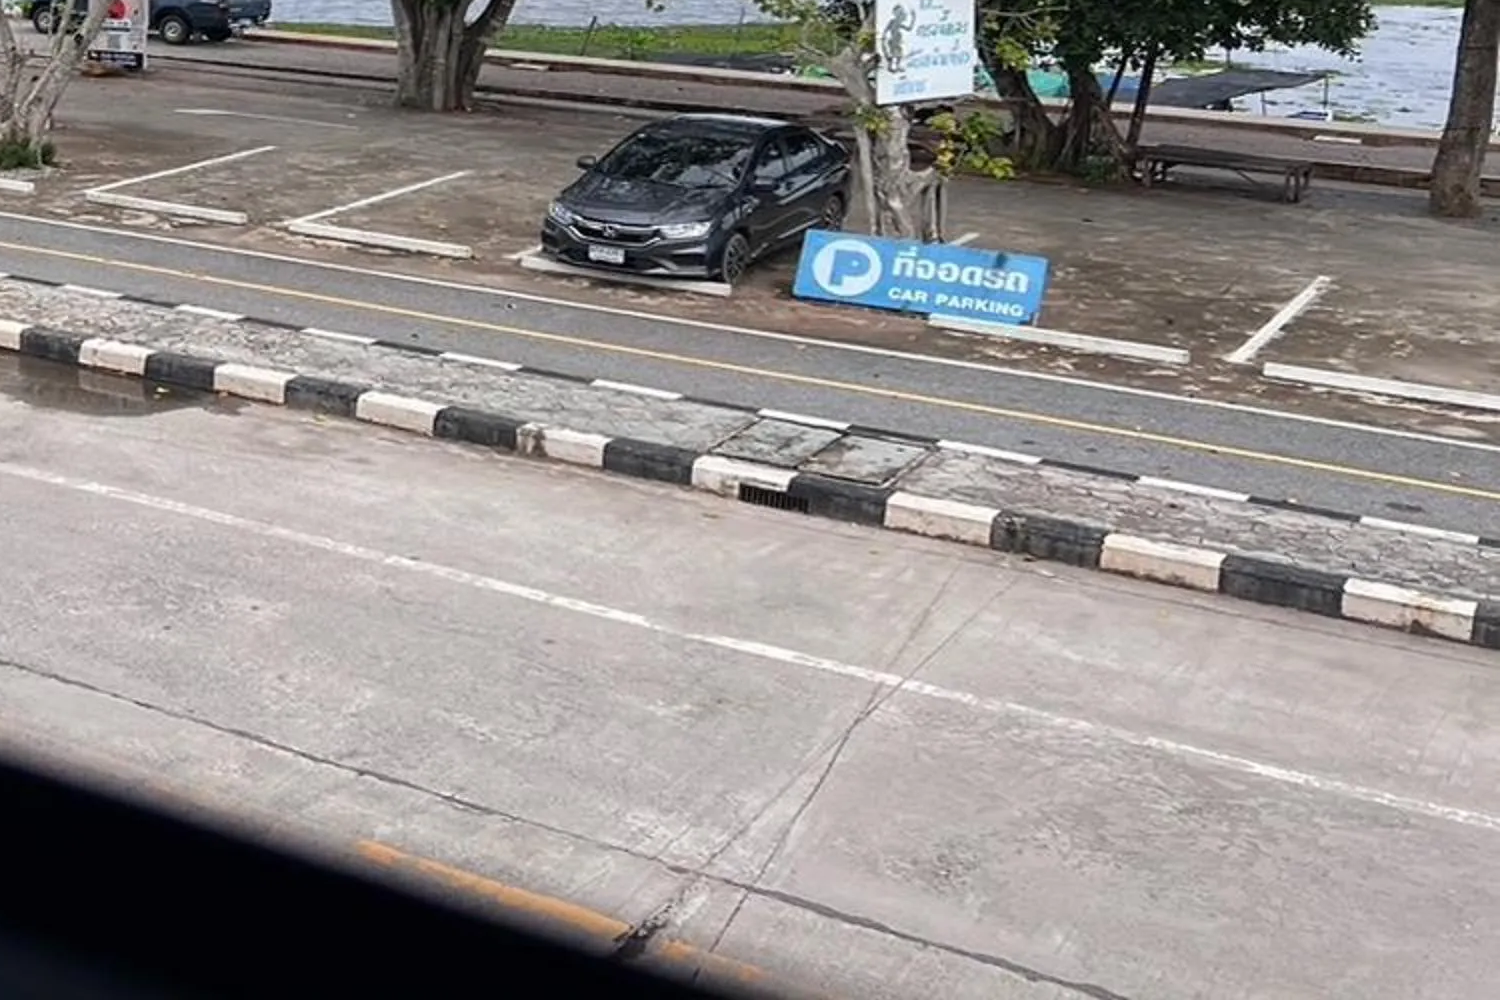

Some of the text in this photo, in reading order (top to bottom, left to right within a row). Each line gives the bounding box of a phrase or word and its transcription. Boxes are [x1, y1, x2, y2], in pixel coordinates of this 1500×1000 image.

[892, 246, 1029, 294] ที่จอดรถ
[888, 286, 1024, 318] CAR PARKING
